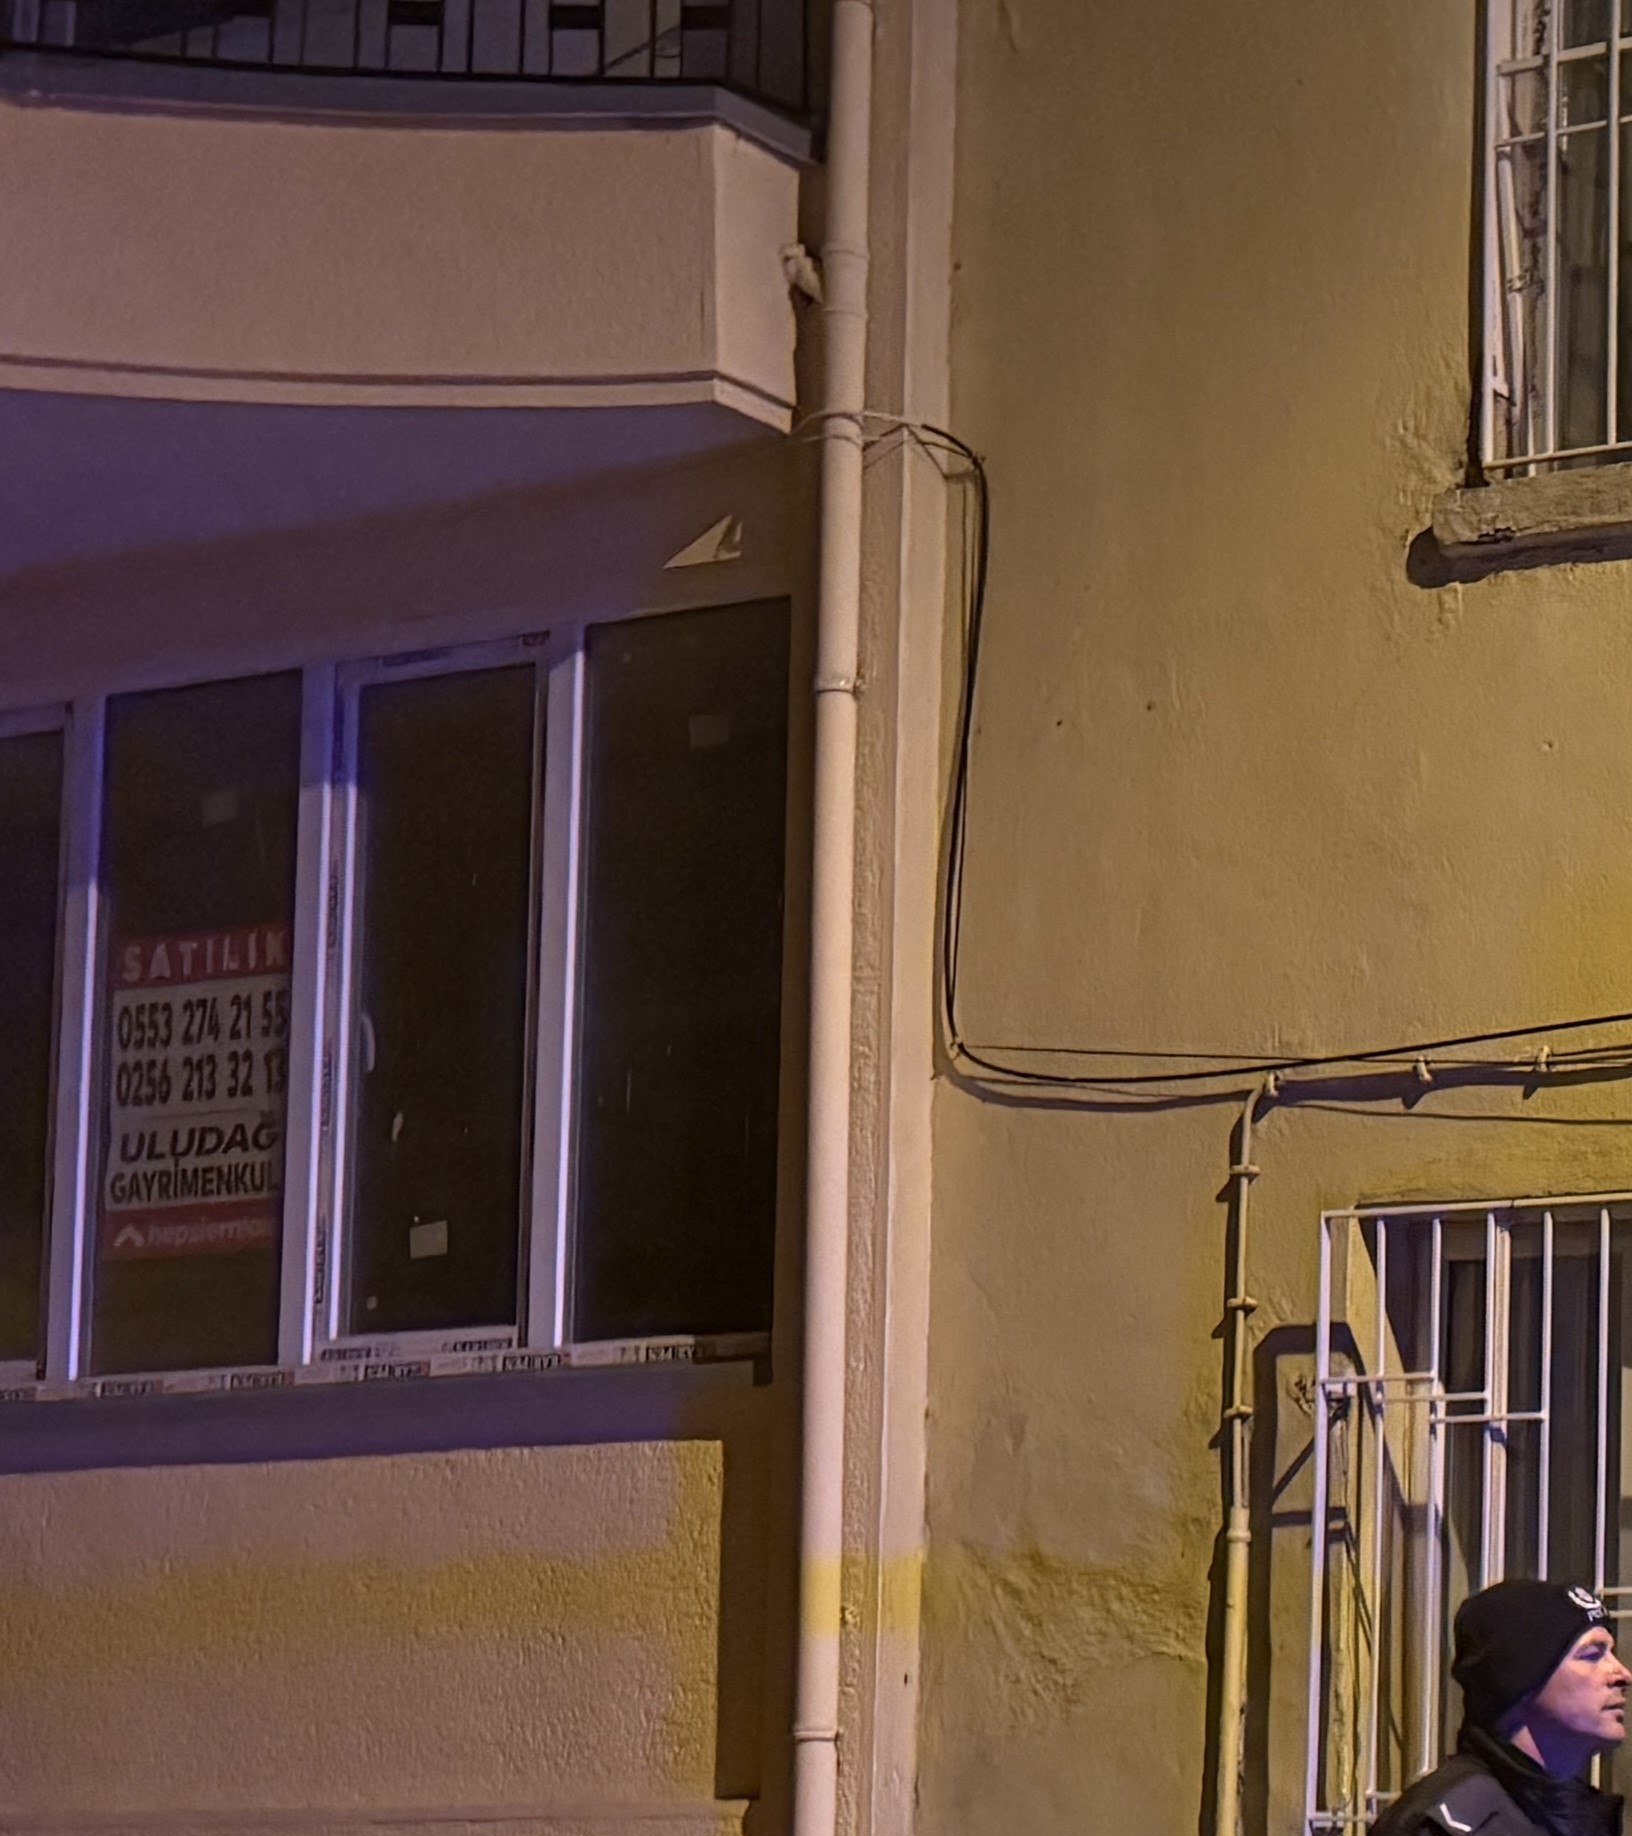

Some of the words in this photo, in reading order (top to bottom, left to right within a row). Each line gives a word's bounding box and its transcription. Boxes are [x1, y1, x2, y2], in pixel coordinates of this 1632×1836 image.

[117, 1001, 172, 1050] 0553
[182, 997, 220, 1046] 274
[230, 994, 252, 1041] 21
[116, 1057, 171, 1107] 0256
[182, 1052, 217, 1102] 213
[227, 1048, 253, 1099] 32
[120, 1110, 279, 1163] ULUDAĞ
